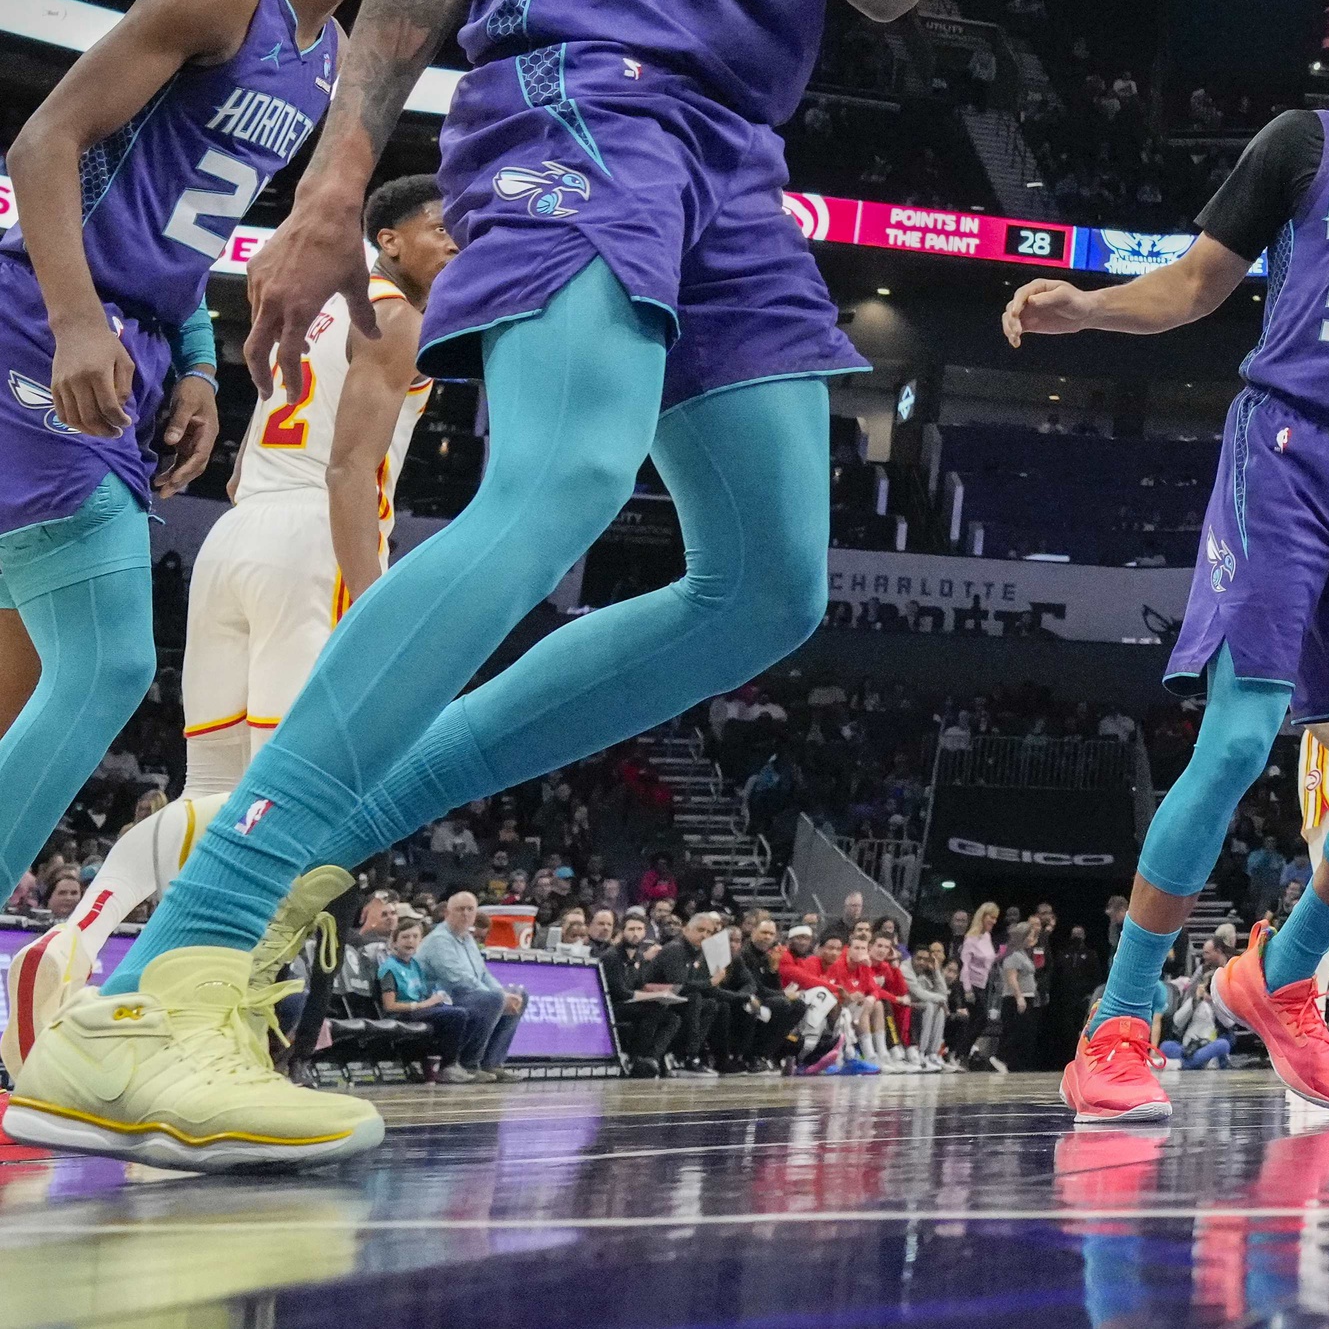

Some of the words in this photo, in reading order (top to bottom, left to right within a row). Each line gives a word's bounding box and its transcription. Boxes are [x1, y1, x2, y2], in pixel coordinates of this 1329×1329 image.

[205, 87, 314, 164] HORNET
[891, 207, 955, 232] POINTS
[959, 217, 979, 234] IN
[886, 228, 921, 250] THE
[924, 234, 979, 255] PAINT
[1017, 230, 1052, 256] 28
[829, 573, 1017, 601] CHARLOTTE
[949, 837, 1114, 866] GEICO
